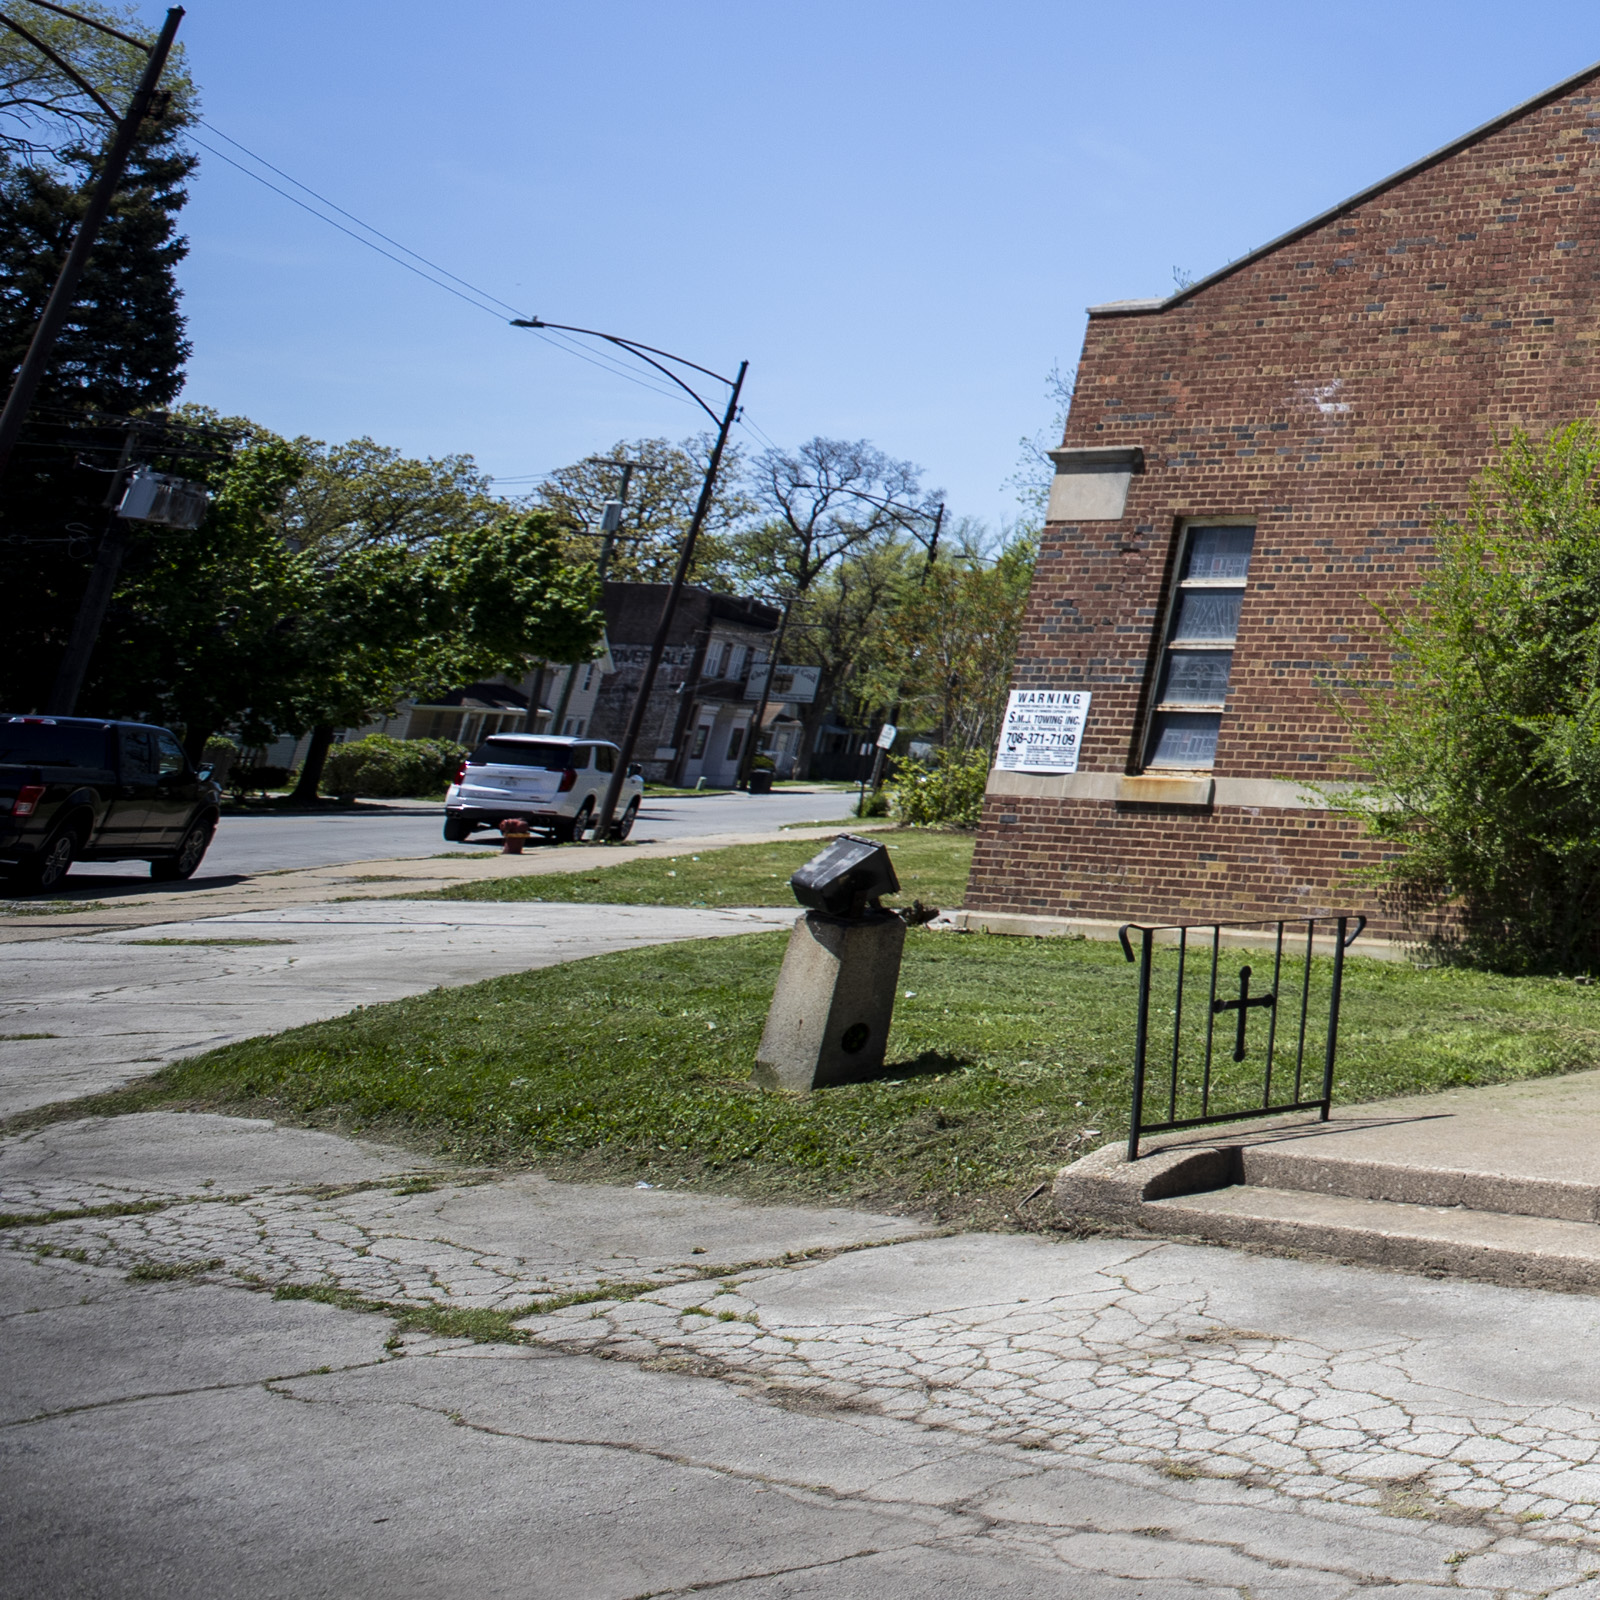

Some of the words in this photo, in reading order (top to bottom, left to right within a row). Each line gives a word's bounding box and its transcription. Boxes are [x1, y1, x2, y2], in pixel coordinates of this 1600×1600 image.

[1018, 692, 1081, 705] WARNING
[1033, 715, 1063, 725] TOWING
[1065, 716, 1081, 726] INC.
[1006, 732, 1076, 746] 708-371-7109
